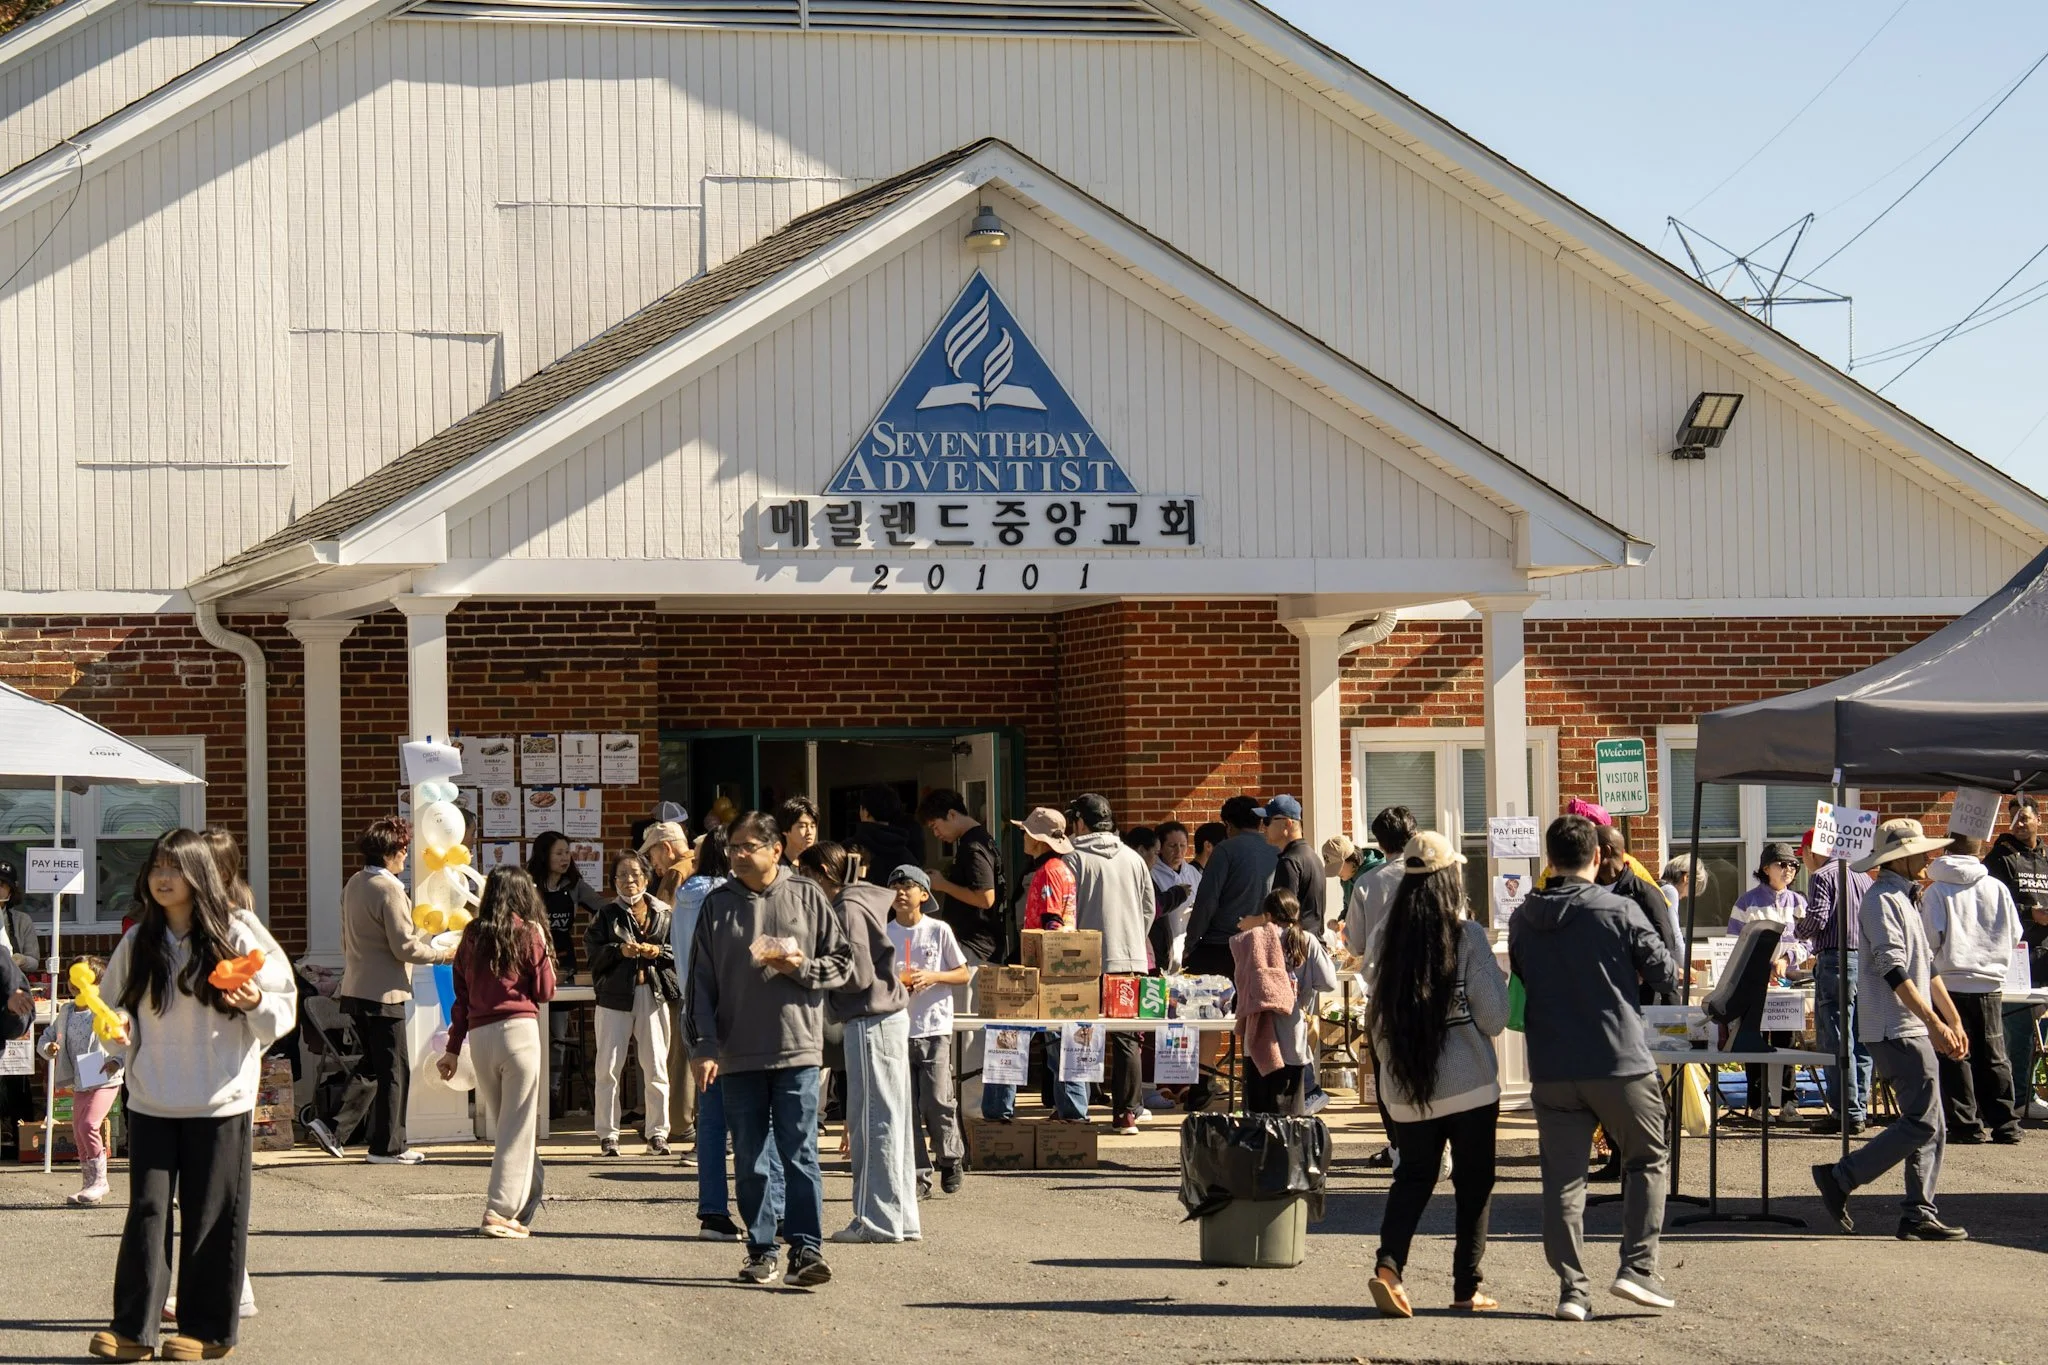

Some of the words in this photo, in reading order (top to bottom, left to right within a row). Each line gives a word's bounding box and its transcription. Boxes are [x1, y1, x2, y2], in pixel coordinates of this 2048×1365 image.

[871, 421, 1095, 458] SEVENTH-DAY
[838, 451, 1117, 492] ADVENTIST
[1599, 747, 1643, 758] Welcome
[1605, 771, 1639, 784] VISITOR
[1604, 790, 1643, 802] PARKING
[1493, 827, 1509, 835] PAY
[1511, 827, 1535, 835] HERE
[1817, 819, 1872, 838] BALLOON
[1820, 833, 1863, 849] BOOTH
[31, 859, 51, 868] PAY
[53, 860, 80, 869] HERE
[2019, 879, 2048, 889] PRAY
